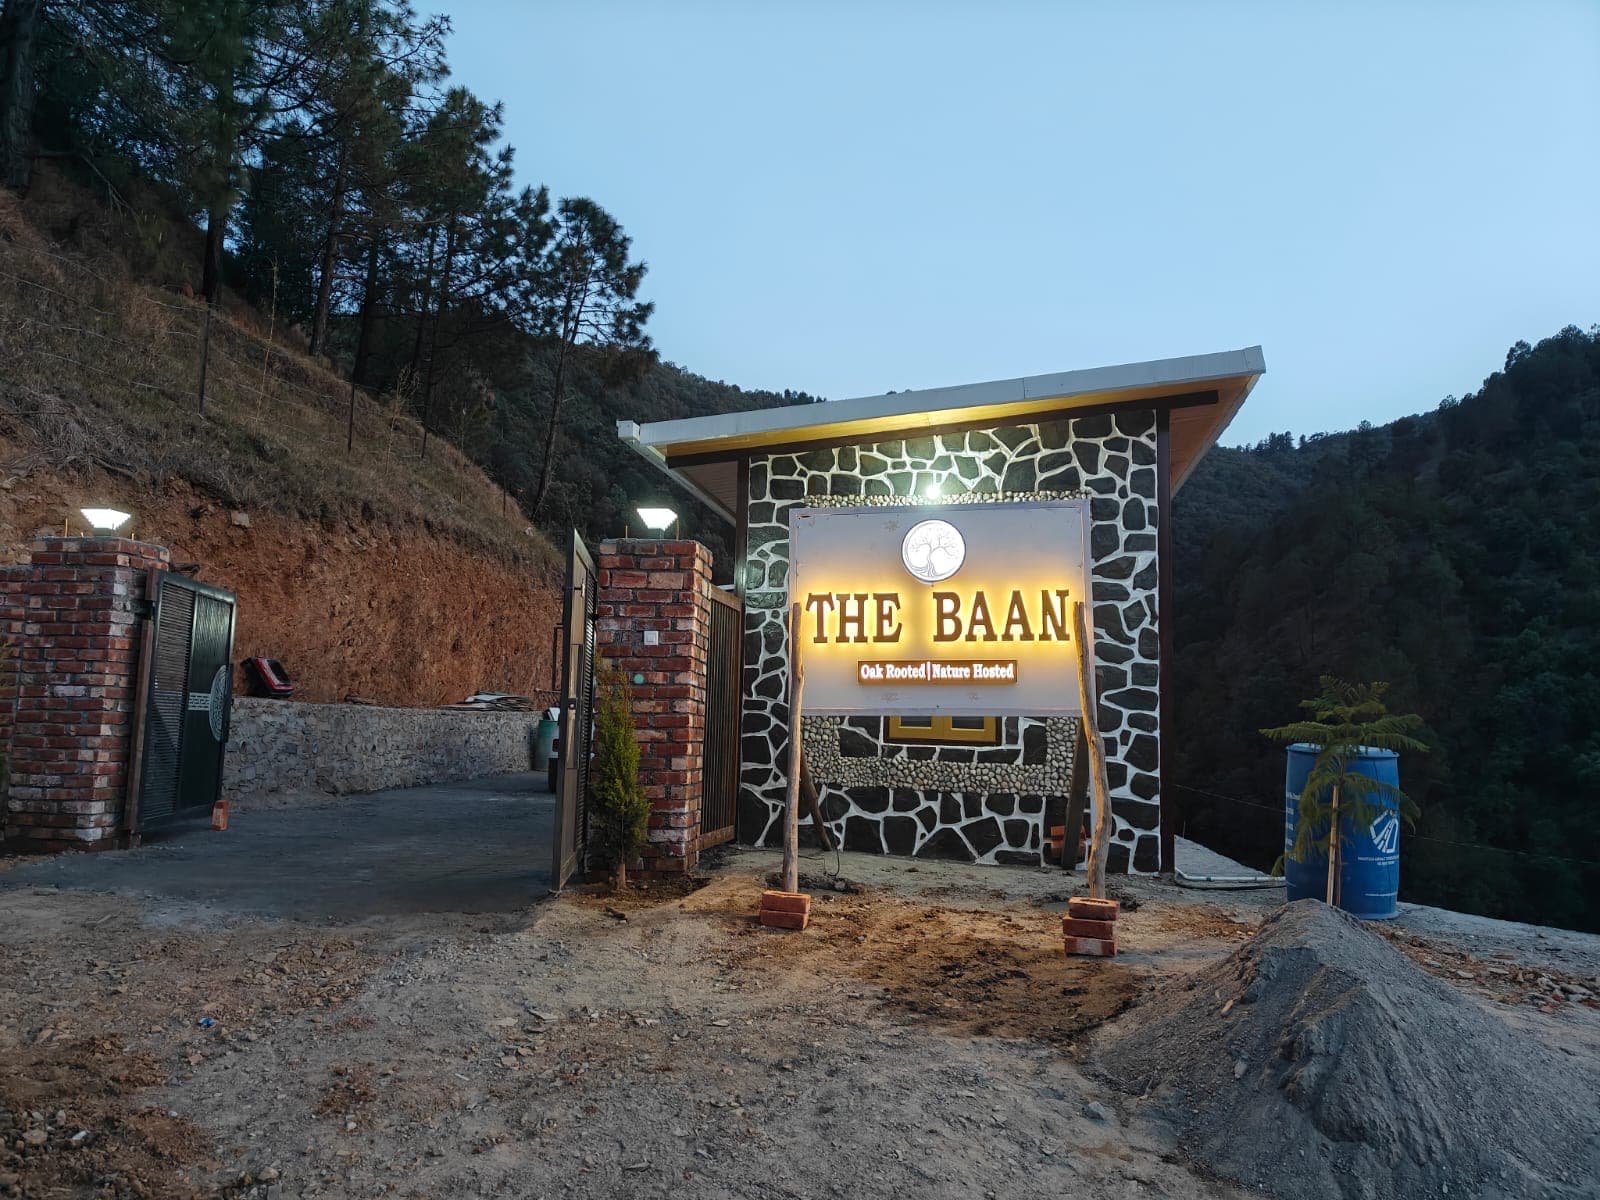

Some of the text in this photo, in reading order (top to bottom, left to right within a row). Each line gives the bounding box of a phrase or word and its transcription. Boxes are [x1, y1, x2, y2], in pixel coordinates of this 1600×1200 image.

[805, 589, 1071, 644] THE BAAN
[860, 663, 884, 679] Oak
[885, 663, 926, 679] Rooted
[932, 663, 971, 679] Nature
[973, 663, 1015, 679] Hosted
